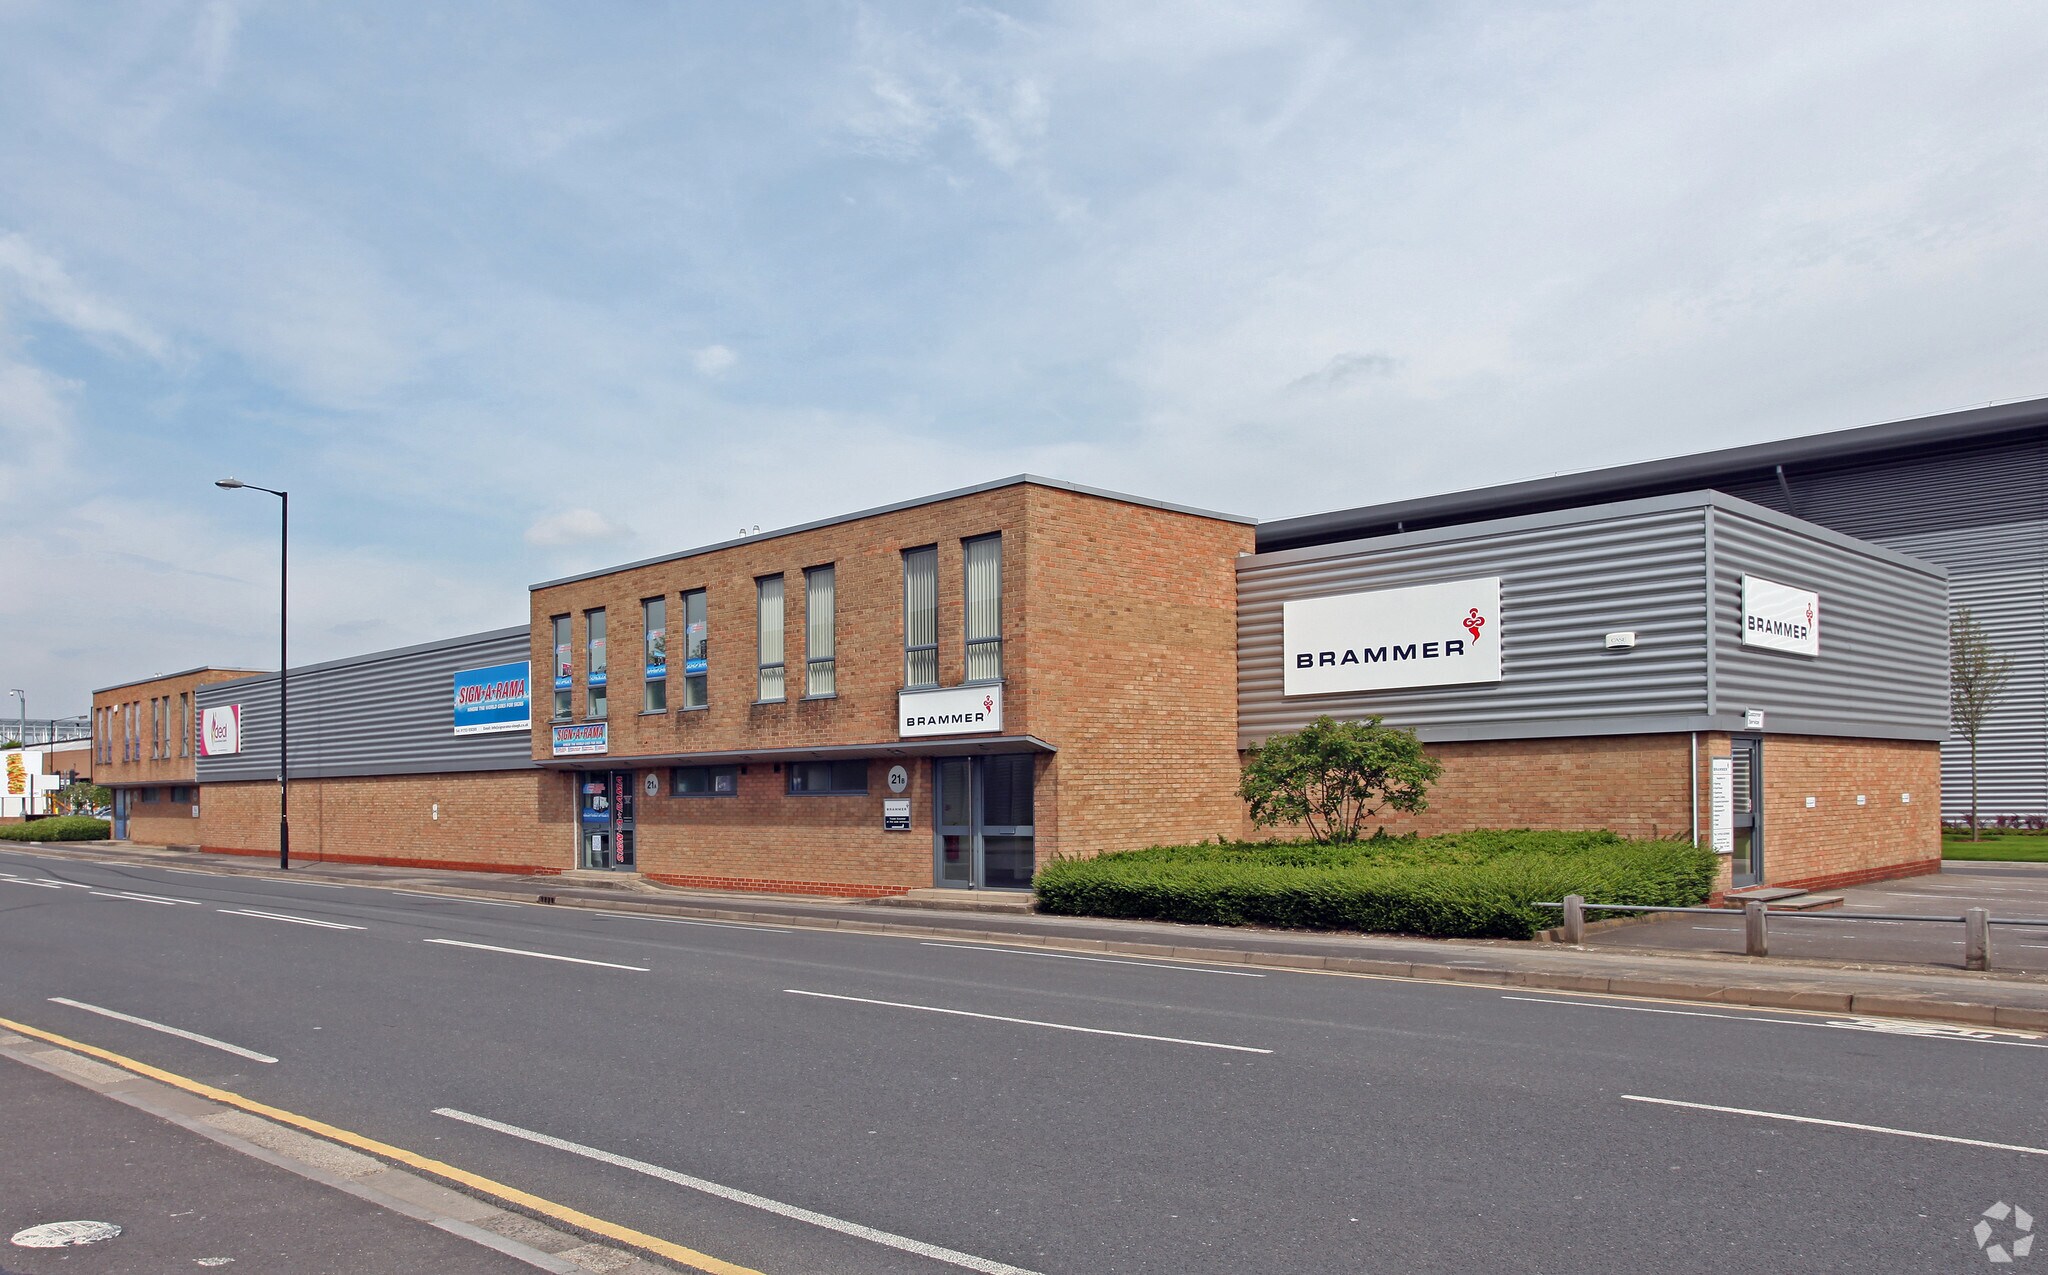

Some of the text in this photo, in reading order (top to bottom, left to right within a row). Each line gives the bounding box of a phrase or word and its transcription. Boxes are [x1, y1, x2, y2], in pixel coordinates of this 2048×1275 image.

[1748, 615, 1808, 640] BRAMMER
[1296, 639, 1464, 669] BRAMMER
[906, 712, 984, 727] BRAMMER
